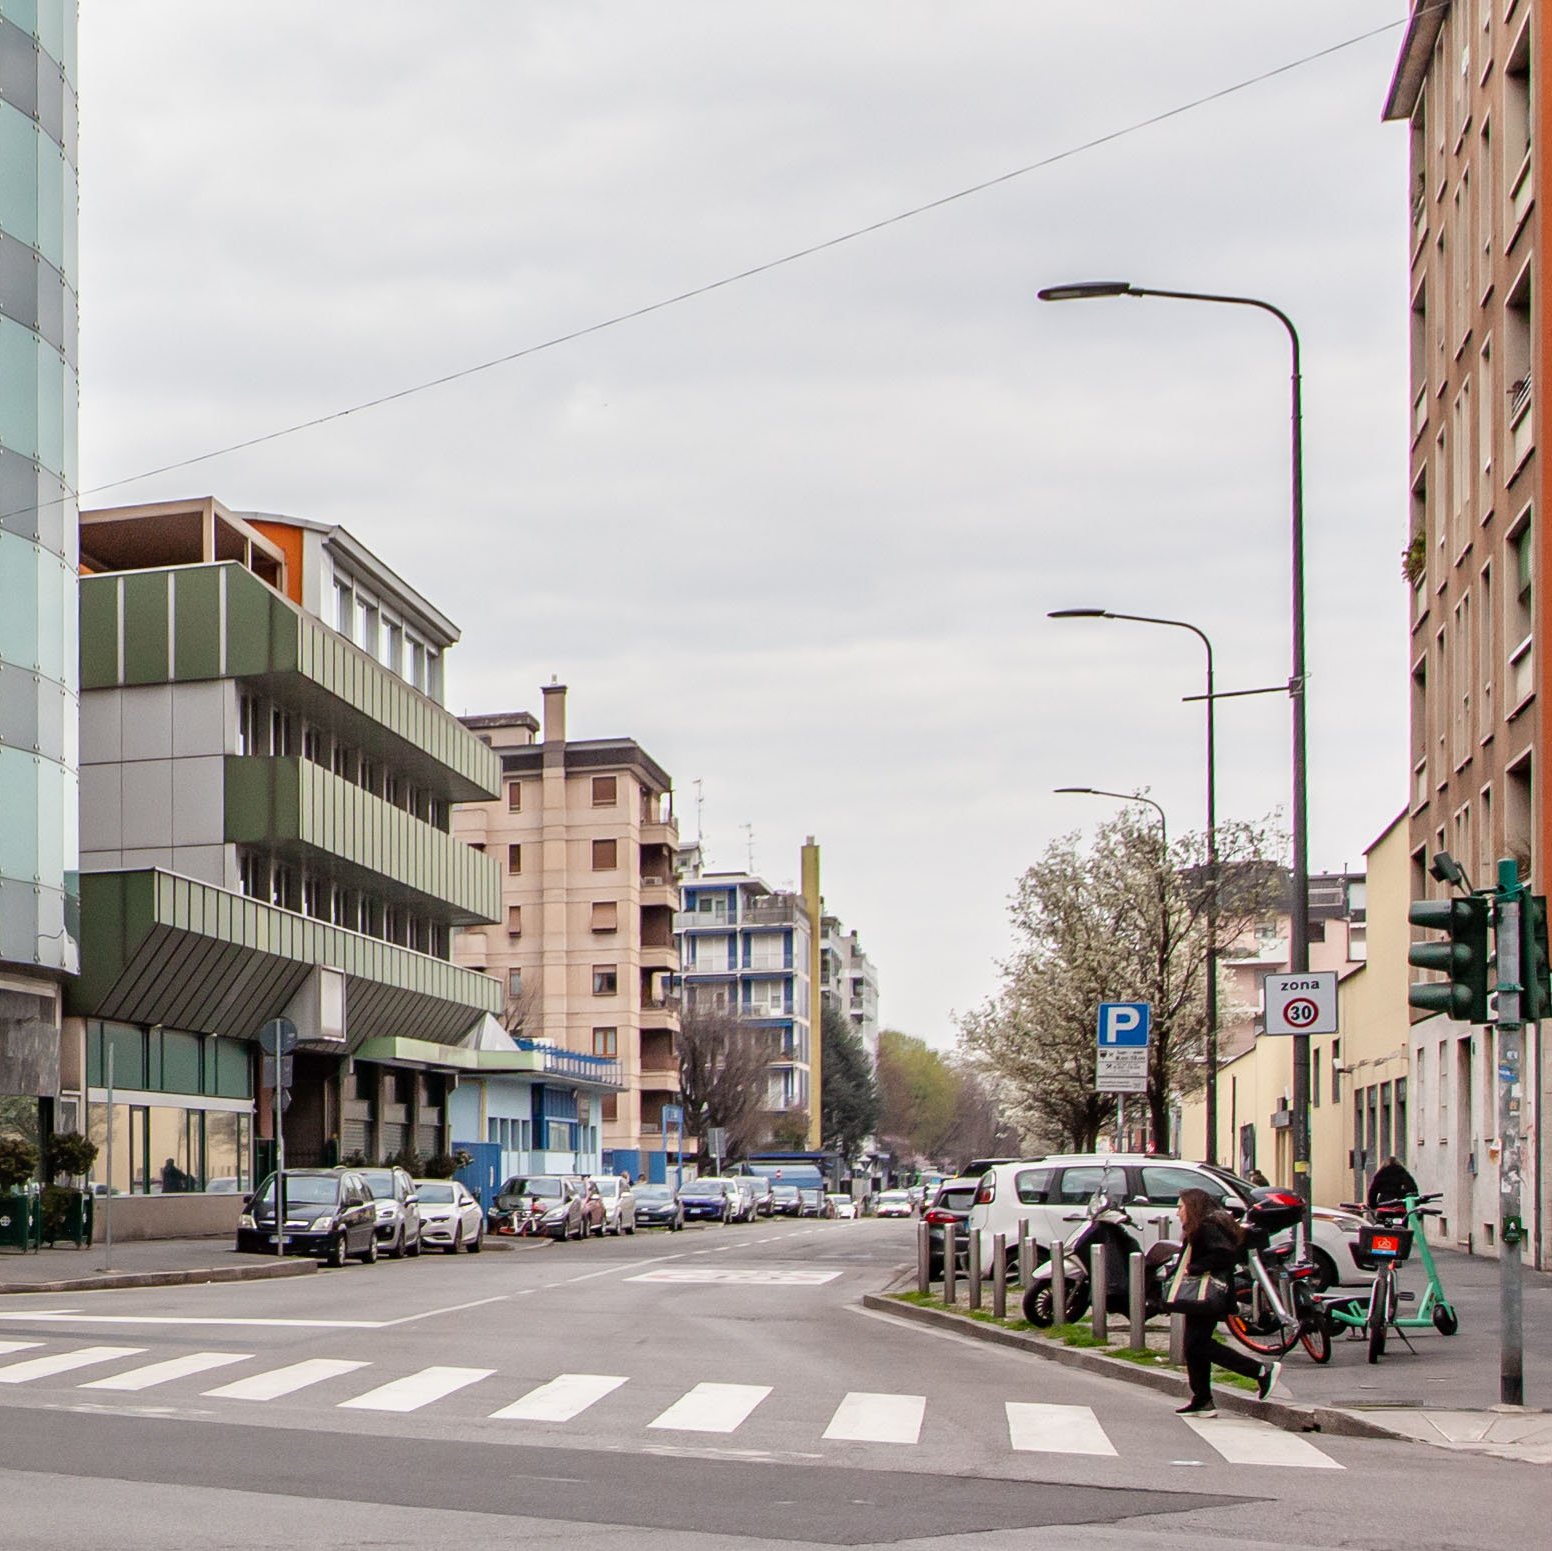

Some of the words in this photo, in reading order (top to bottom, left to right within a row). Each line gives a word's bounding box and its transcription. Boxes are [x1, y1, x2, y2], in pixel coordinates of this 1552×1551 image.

[1281, 980, 1319, 991] zona
[1291, 1005, 1312, 1021] 30
[1106, 1006, 1140, 1043] P
